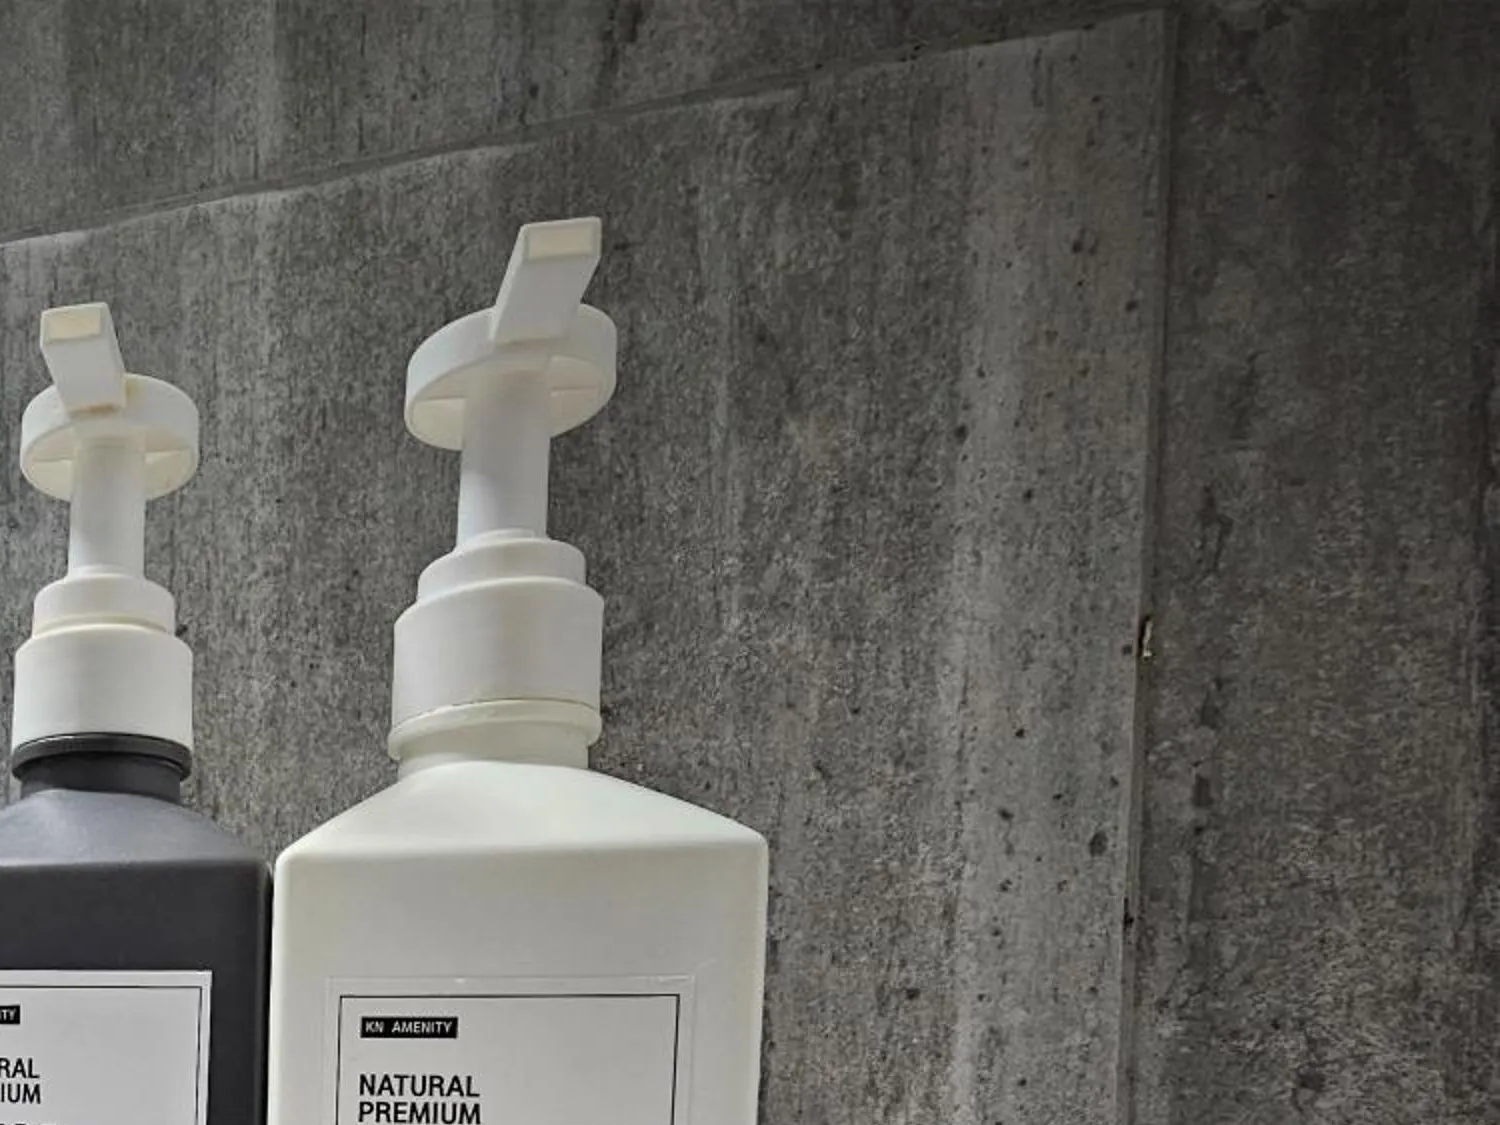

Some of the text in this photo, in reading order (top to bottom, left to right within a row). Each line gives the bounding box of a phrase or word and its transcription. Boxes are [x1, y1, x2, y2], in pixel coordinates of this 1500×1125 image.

[365, 1021, 452, 1033] KN AMENITY
[359, 1073, 480, 1097] NATURAL
[358, 1101, 481, 1125] PREMIUM
